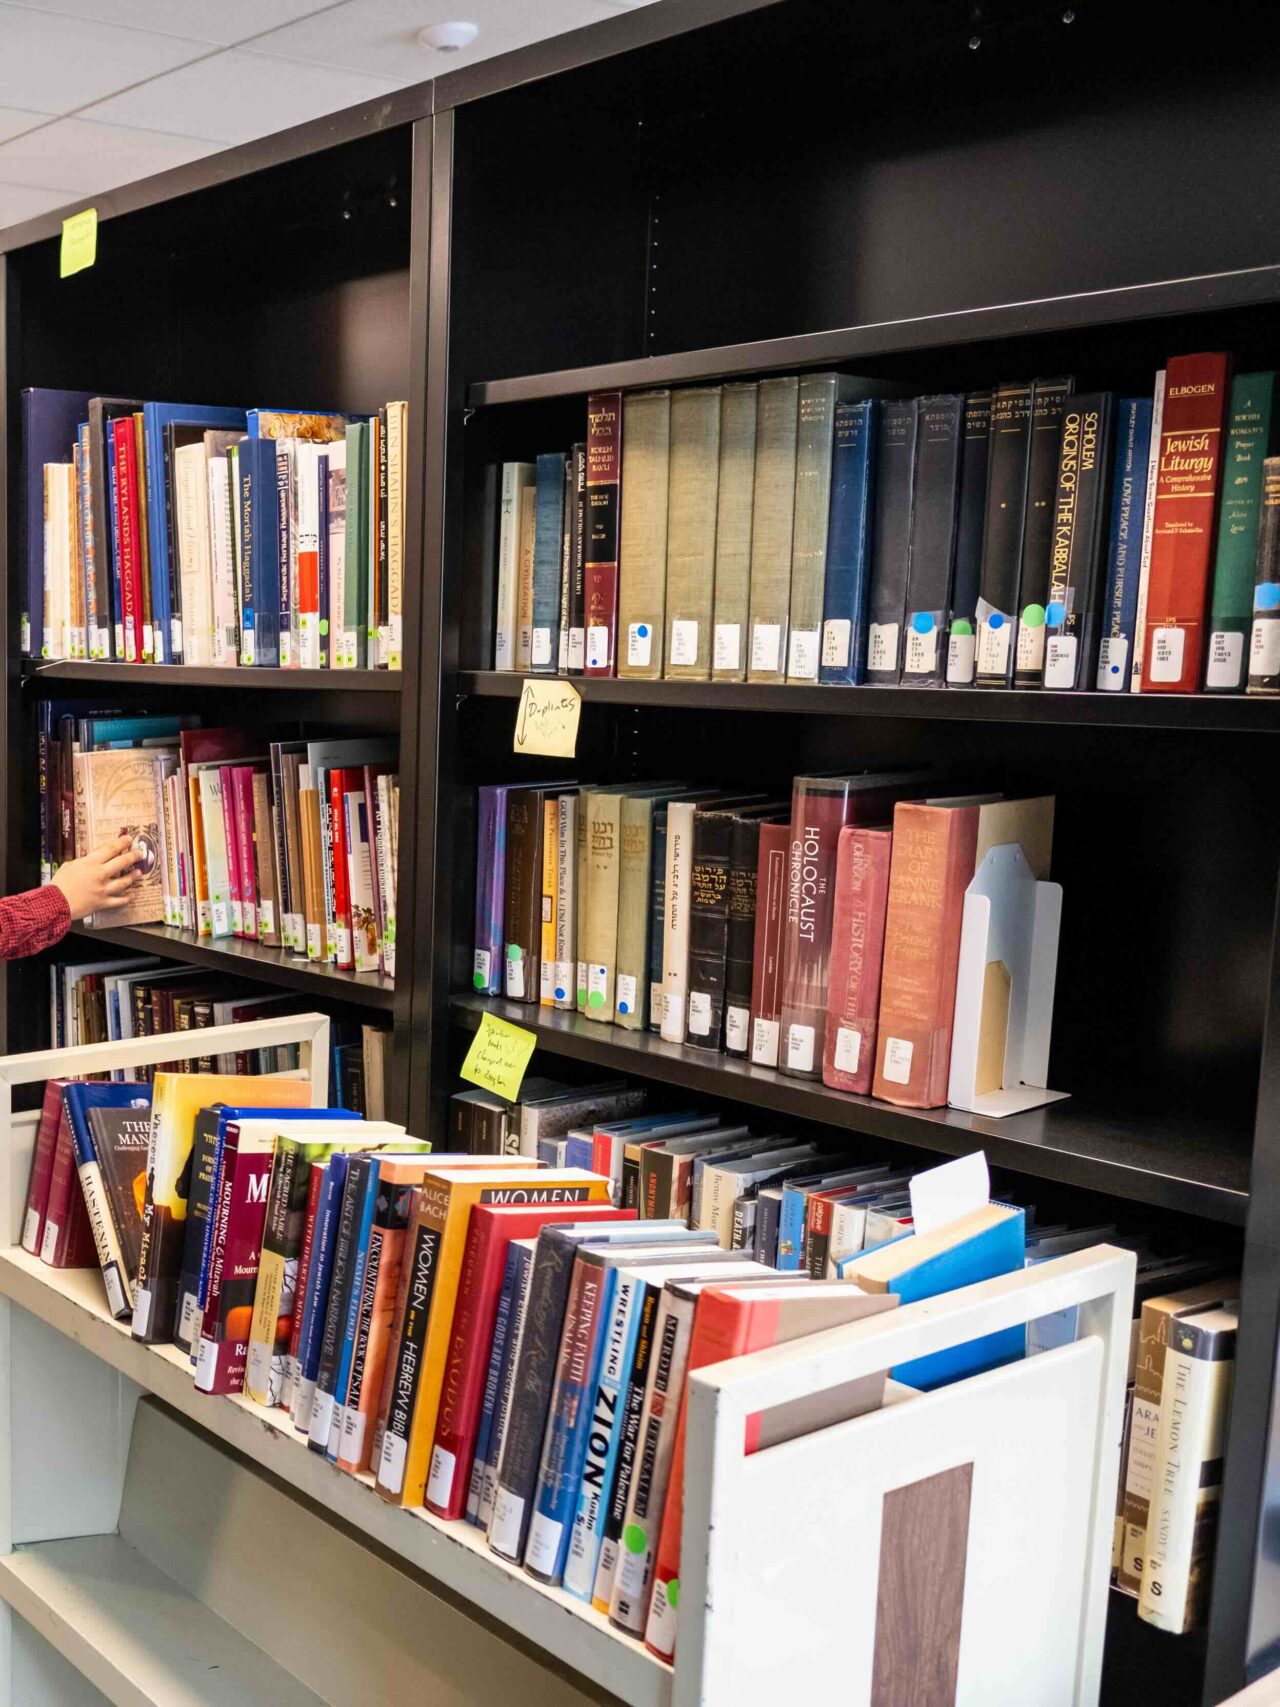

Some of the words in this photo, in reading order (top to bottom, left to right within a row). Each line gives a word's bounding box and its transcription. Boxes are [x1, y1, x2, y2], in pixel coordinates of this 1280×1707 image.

[1169, 383, 1215, 396] ELBOGEN
[388, 414, 399, 448] BEN
[1060, 412, 1080, 472] ORIGINS
[1081, 411, 1098, 471] SCHOLEM
[1166, 433, 1210, 455] Jewish
[118, 443, 127, 476] THE
[1160, 455, 1214, 473] Liturgy
[243, 474, 252, 497] The
[389, 452, 400, 527] SHAHN'S
[1060, 473, 1076, 492] OF
[1159, 476, 1165, 484] A
[1166, 473, 1212, 484] Comprehensive
[1171, 484, 1195, 492] History
[119, 477, 132, 545] RYLANDS
[244, 500, 252, 542] Moriah
[1057, 493, 1073, 524] THE
[242, 545, 253, 602] Haggadah
[1049, 524, 1071, 604] KABBALAH
[559, 800, 567, 820] GOD
[559, 821, 567, 839] Was
[559, 839, 567, 849] In
[905, 829, 937, 845] THE
[559, 849, 567, 865] This
[850, 841, 865, 891] JOHNSON
[898, 842, 938, 861] DIARY
[788, 840, 803, 924] CHRONICLE
[908, 861, 929, 875] OF
[799, 826, 820, 943] HOLOCAUST
[818, 877, 827, 895] THE
[894, 875, 941, 892] ANNE
[890, 889, 943, 908] FRANK
[849, 911, 866, 973] HISTORY
[848, 975, 858, 991] OF
[845, 996, 857, 1018] THE
[282, 1167, 295, 1207] SACRED
[348, 1169, 360, 1194] THE
[713, 1174, 723, 1203] Benny
[343, 1195, 355, 1219] ART
[419, 1187, 451, 1207] ALICE
[419, 1201, 447, 1220] BACH
[490, 1189, 580, 1204] WOMEN
[84, 1175, 113, 1263] HASTENIN
[141, 1203, 154, 1226] My
[218, 1180, 233, 1244] MOURNING
[277, 1208, 289, 1241] TABLE
[733, 1210, 743, 1241] DEATH
[305, 1214, 315, 1243] WITH
[320, 1209, 332, 1252] Innovation
[341, 1221, 352, 1238] OF
[301, 1246, 311, 1281] HEART
[318, 1253, 326, 1262] in
[334, 1238, 349, 1286] BIBLICAL
[412, 1233, 436, 1310] WOMEN
[211, 1257, 225, 1297] Mitzvah
[314, 1263, 326, 1290] Jewish
[352, 1249, 365, 1296] NOAH'S
[361, 1232, 383, 1316] ENCOUNTERING
[519, 1256, 533, 1296] Jewish
[298, 1285, 306, 1297] IN
[312, 1291, 320, 1309] Law
[498, 1295, 511, 1314] THE
[294, 1300, 304, 1328] MIND
[323, 1289, 341, 1355] NARRATIVE
[346, 1299, 359, 1342] FLOOD
[359, 1316, 371, 1332] THE
[409, 1309, 416, 1319] IN
[576, 1281, 597, 1339] KEEPING
[642, 1295, 654, 1324] Rogan
[406, 1319, 416, 1337] THE
[493, 1316, 508, 1345] GODS
[607, 1284, 631, 1376] WRESTLING
[356, 1334, 367, 1358] BOOK
[489, 1346, 502, 1366] ARE
[635, 1338, 649, 1370] Shlaim
[654, 1316, 677, 1392] MURDER
[353, 1360, 363, 1372] OF
[397, 1341, 418, 1406] HEBREW
[568, 1341, 589, 1382] FAITH
[440, 1336, 465, 1437] EXODUS
[482, 1368, 500, 1415] BROKEN!
[1177, 1362, 1192, 1397] THE
[631, 1385, 646, 1412] The
[650, 1393, 665, 1416] IN
[391, 1406, 407, 1438] BIBL
[625, 1414, 639, 1438] War
[1168, 1400, 1188, 1452] LEMON
[583, 1386, 618, 1490] ZION
[621, 1440, 635, 1461] for
[633, 1418, 660, 1519] JERUSALEM
[1164, 1459, 1182, 1498] TREE
[612, 1462, 631, 1520] Palestine
[1133, 1557, 1143, 1572] S
[1150, 1581, 1163, 1597] S
